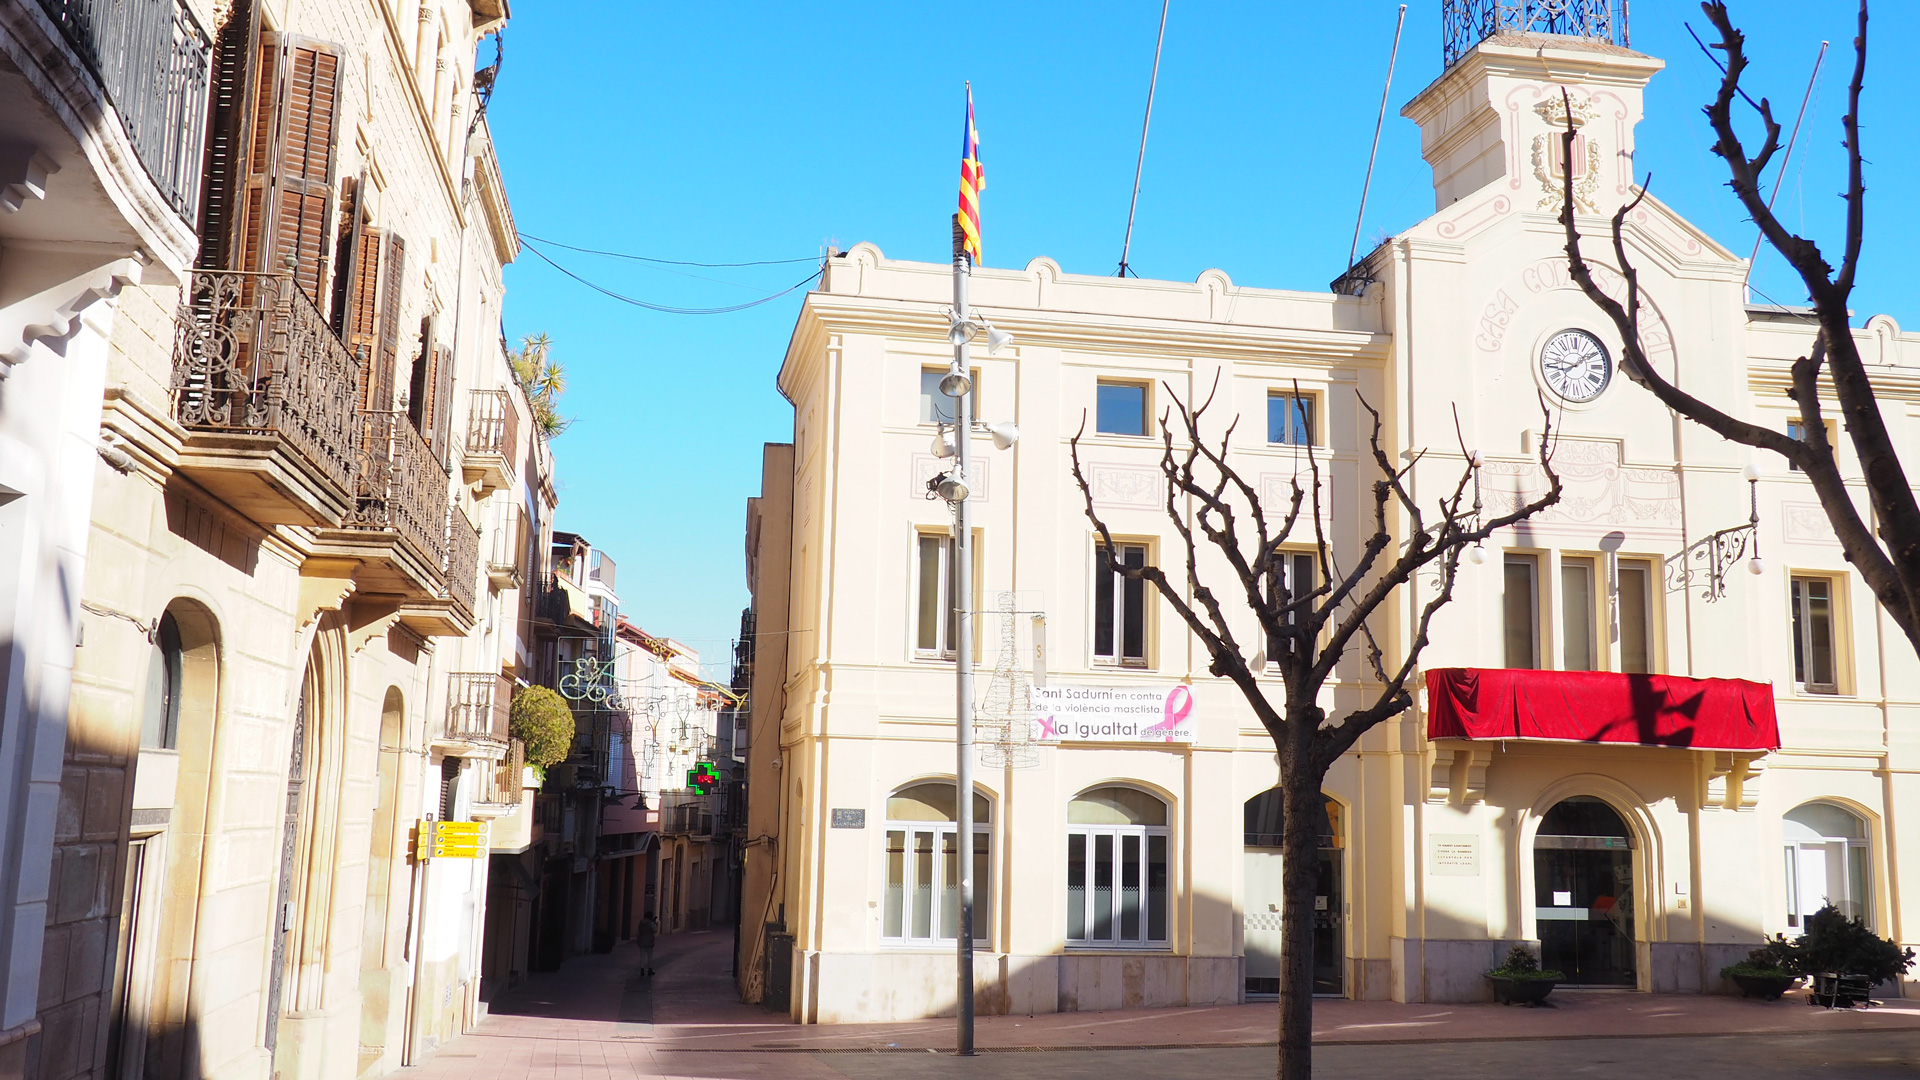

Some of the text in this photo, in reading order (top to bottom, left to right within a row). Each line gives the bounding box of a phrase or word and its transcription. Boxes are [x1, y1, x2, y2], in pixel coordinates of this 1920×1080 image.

[1475, 288, 1520, 353] CASA
[1036, 687, 1062, 698] Sant
[1066, 688, 1114, 700] Sadurní
[1130, 692, 1162, 700] contra
[1035, 703, 1163, 714] de la violència masclista.
[1075, 721, 1138, 739] Igualtat
[1140, 728, 1153, 736] de
[1155, 726, 1192, 738] gènere.
